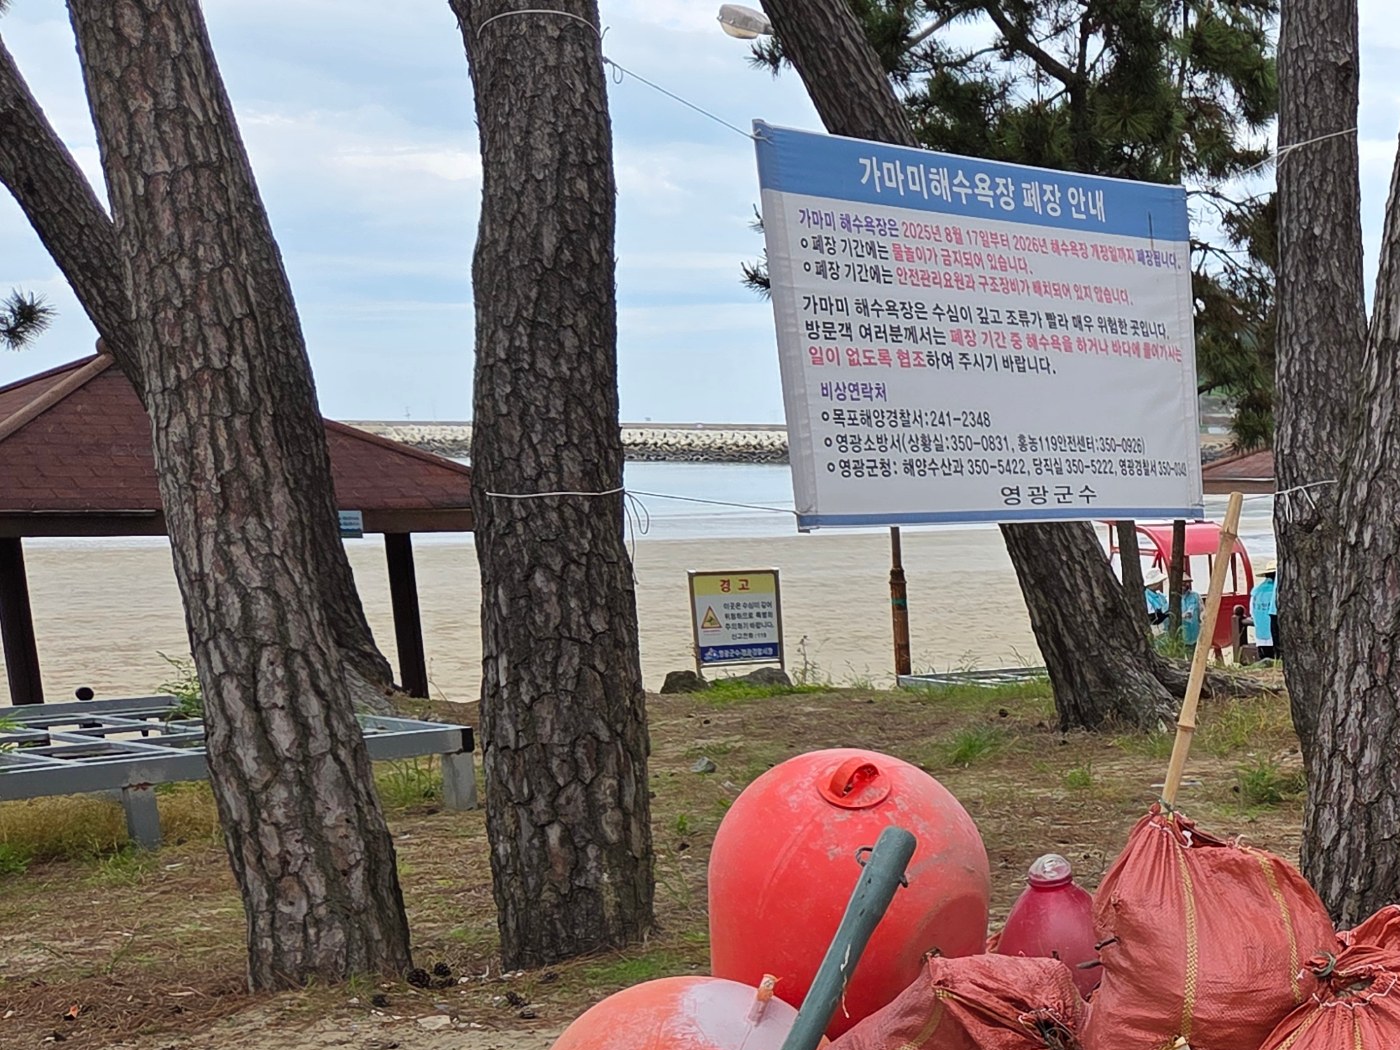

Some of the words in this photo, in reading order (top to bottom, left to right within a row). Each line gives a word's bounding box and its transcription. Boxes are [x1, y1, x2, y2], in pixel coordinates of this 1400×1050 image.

[858, 156, 1016, 212] 가마미해수욕장
[1021, 181, 1062, 217] 폐장
[1067, 186, 1106, 223] 안내
[799, 208, 836, 231] 가마미
[839, 213, 900, 238] 해수욕장은
[901, 221, 942, 243] 2025년
[944, 226, 964, 245] 8월
[966, 229, 1010, 250] 17일부터
[1012, 234, 1048, 254] 2026년
[1050, 238, 1089, 260] 해수욕장
[811, 234, 837, 256] 폐장
[840, 238, 889, 260] 기간에는
[891, 242, 938, 265] 물놀이가
[941, 248, 985, 270] 금지되어
[987, 251, 1033, 275] 있습니다.
[814, 259, 840, 280] 폐장
[844, 262, 893, 285] 기간에는
[896, 266, 976, 291] 안전관리요원과
[978, 275, 1030, 297] 구조장비가
[1032, 279, 1072, 300] 배치되어
[1073, 283, 1093, 302] 있지
[1094, 286, 1134, 306] 않습니다.
[802, 294, 850, 317] 가마미
[854, 298, 929, 320] 해수욕장은
[932, 302, 973, 324] 수심이
[976, 306, 1003, 325] 깊고
[1005, 309, 1042, 329] 조류가
[1045, 311, 1069, 331] 빨라
[1071, 314, 1094, 333] 매우
[1097, 316, 1128, 336] 위험한
[1129, 319, 1170, 340] 곳입니다.
[805, 320, 853, 342] 방문객
[858, 323, 947, 346] 여러분께서는
[949, 328, 977, 348] 폐장
[980, 330, 1007, 350] 기간
[1010, 331, 1023, 350] 중
[1025, 332, 1074, 353] 해수욕을
[1075, 335, 1109, 356] 하거나
[1111, 339, 1141, 358] 바다에
[808, 345, 841, 366] 일이
[845, 346, 893, 368] 없도록
[896, 348, 955, 370] 협조하여
[958, 351, 999, 372] 주시기
[1002, 354, 1057, 375] 바랍니다.
[820, 381, 888, 402] 비상연락처
[838, 457, 898, 478] 영광군청:
[902, 457, 965, 478] 해양수산과
[967, 458, 1030, 477] 350-5422,
[1032, 457, 1064, 477] 당직실
[1065, 458, 1118, 477] 350-5222,
